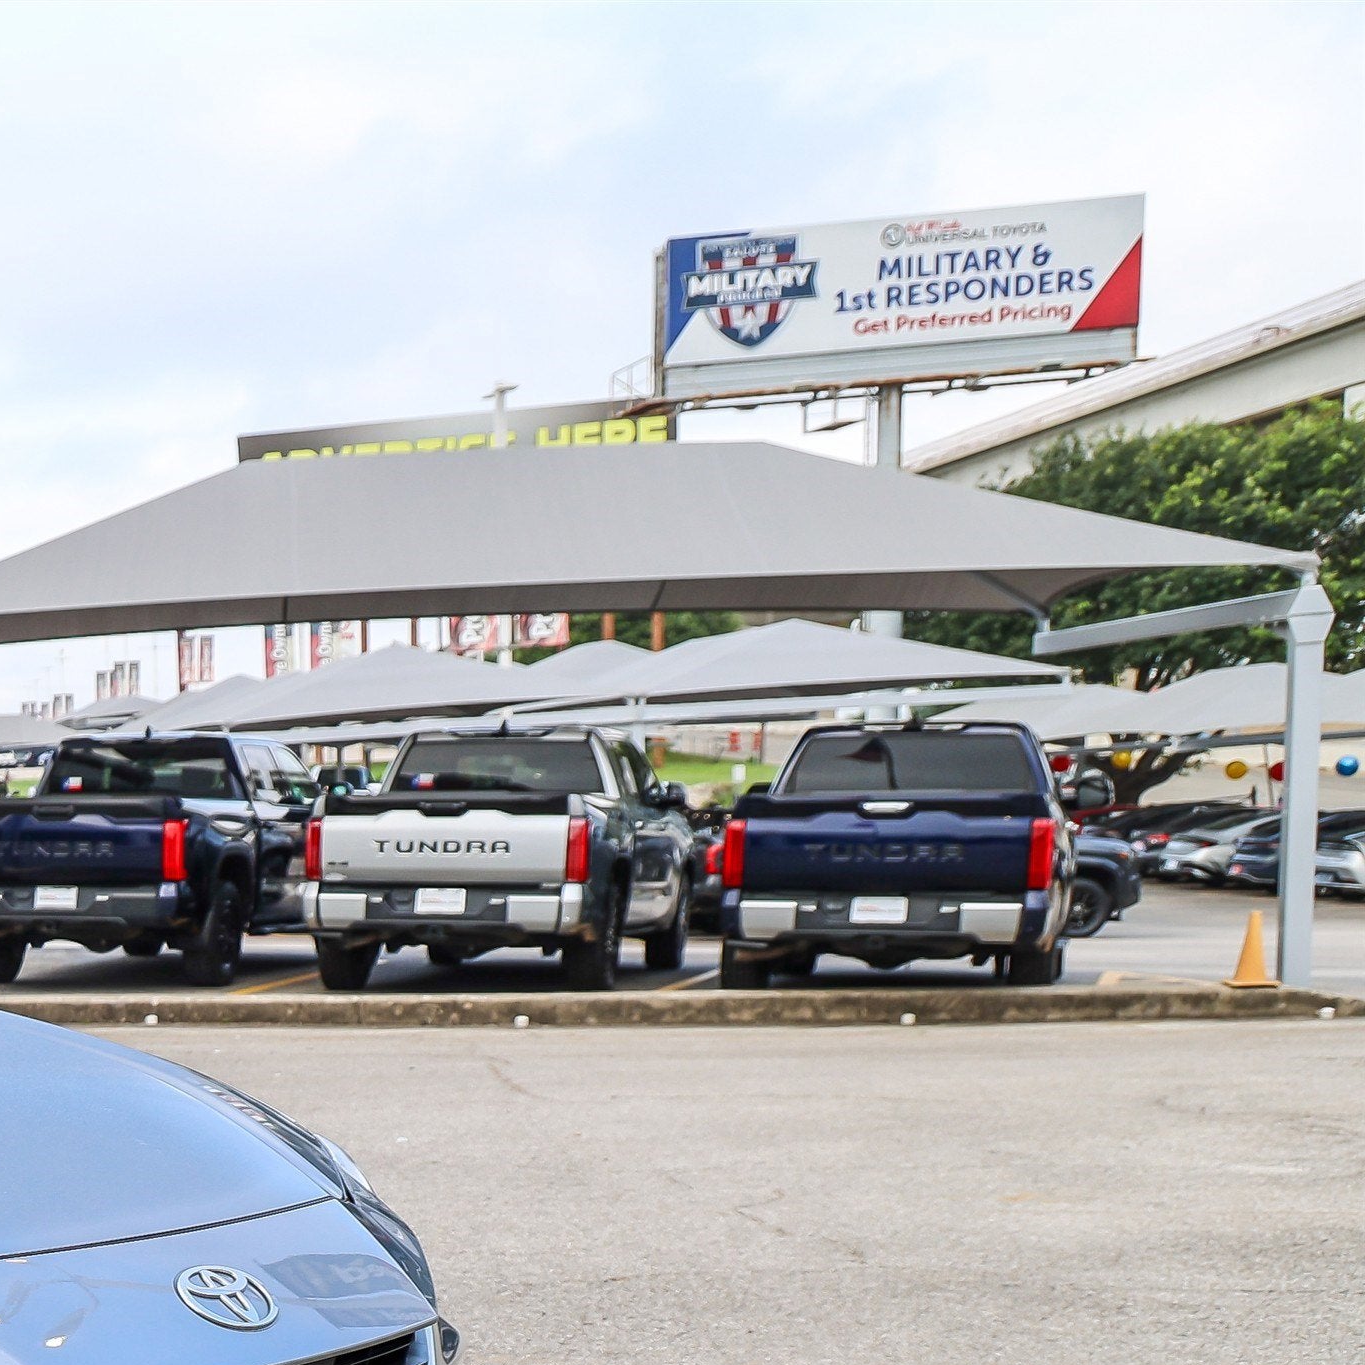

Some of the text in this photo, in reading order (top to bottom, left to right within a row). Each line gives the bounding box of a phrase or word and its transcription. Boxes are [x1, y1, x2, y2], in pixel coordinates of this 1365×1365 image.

[906, 222, 1047, 246] UNIVERSAL TOYOTA
[878, 242, 1053, 281] MILITARY &
[688, 264, 812, 297] MILITARY
[835, 268, 1095, 312] 1st RESPONDERS
[854, 303, 1072, 336] Get Preferred Pricing
[373, 840, 511, 854] TUNDRA
[804, 844, 965, 862] TUNDRA
